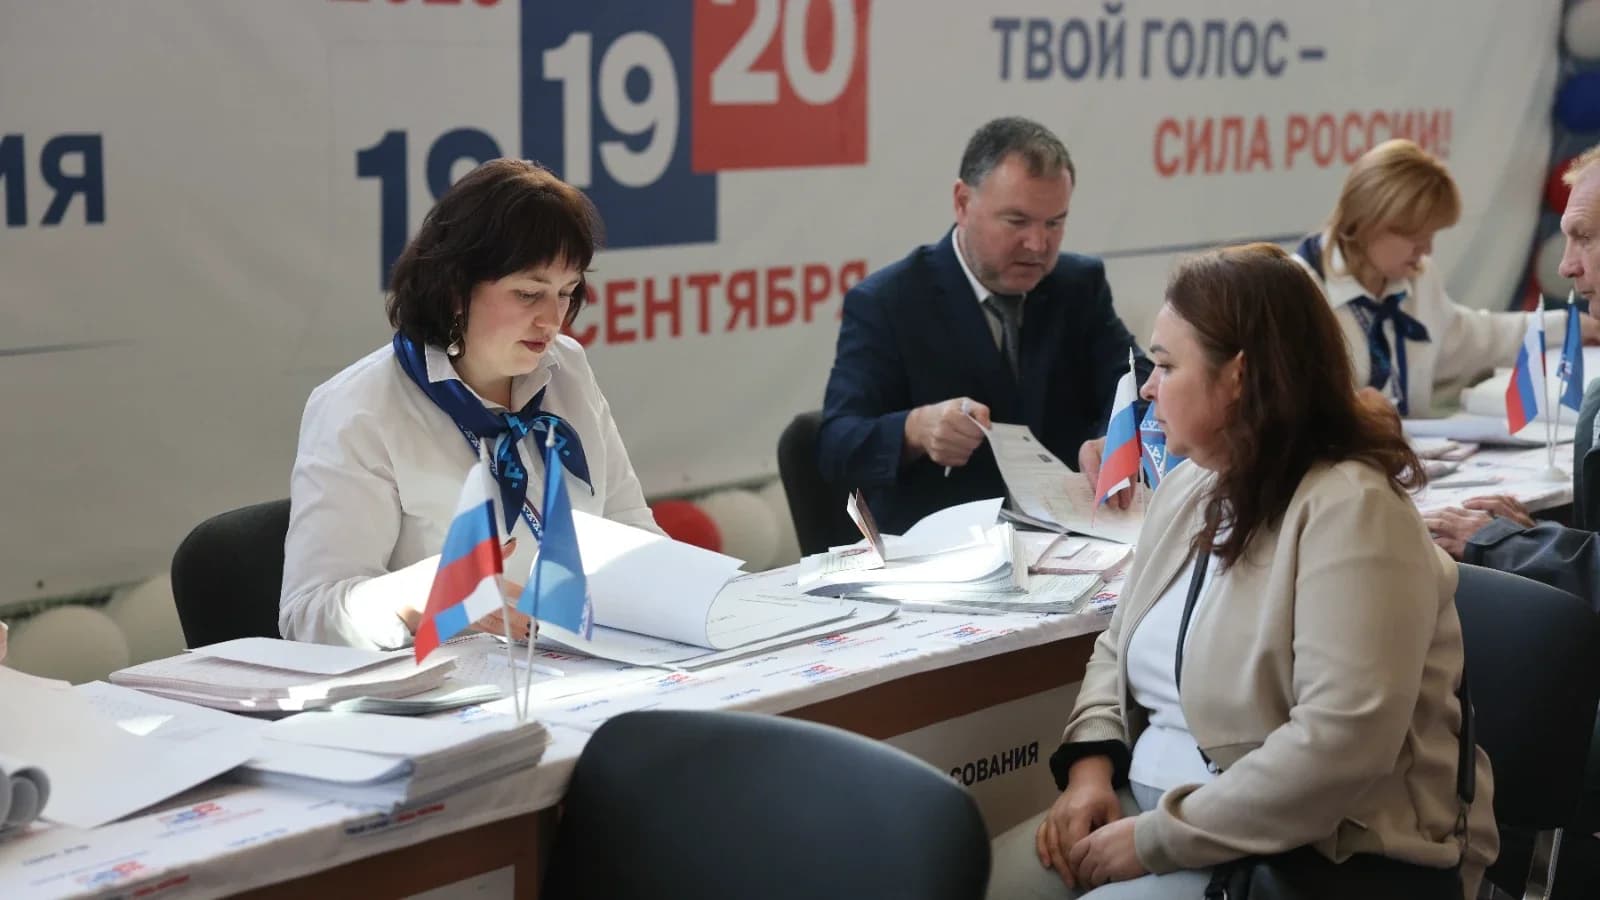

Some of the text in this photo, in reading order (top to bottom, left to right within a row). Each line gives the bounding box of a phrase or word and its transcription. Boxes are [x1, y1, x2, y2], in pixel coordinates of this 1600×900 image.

[711, 0, 857, 104] 20
[992, 2, 1127, 80] ТВОЙ
[1141, 20, 1289, 79] ГОЛОС
[543, 31, 680, 188] 19
[1153, 112, 1273, 178] СИЛА
